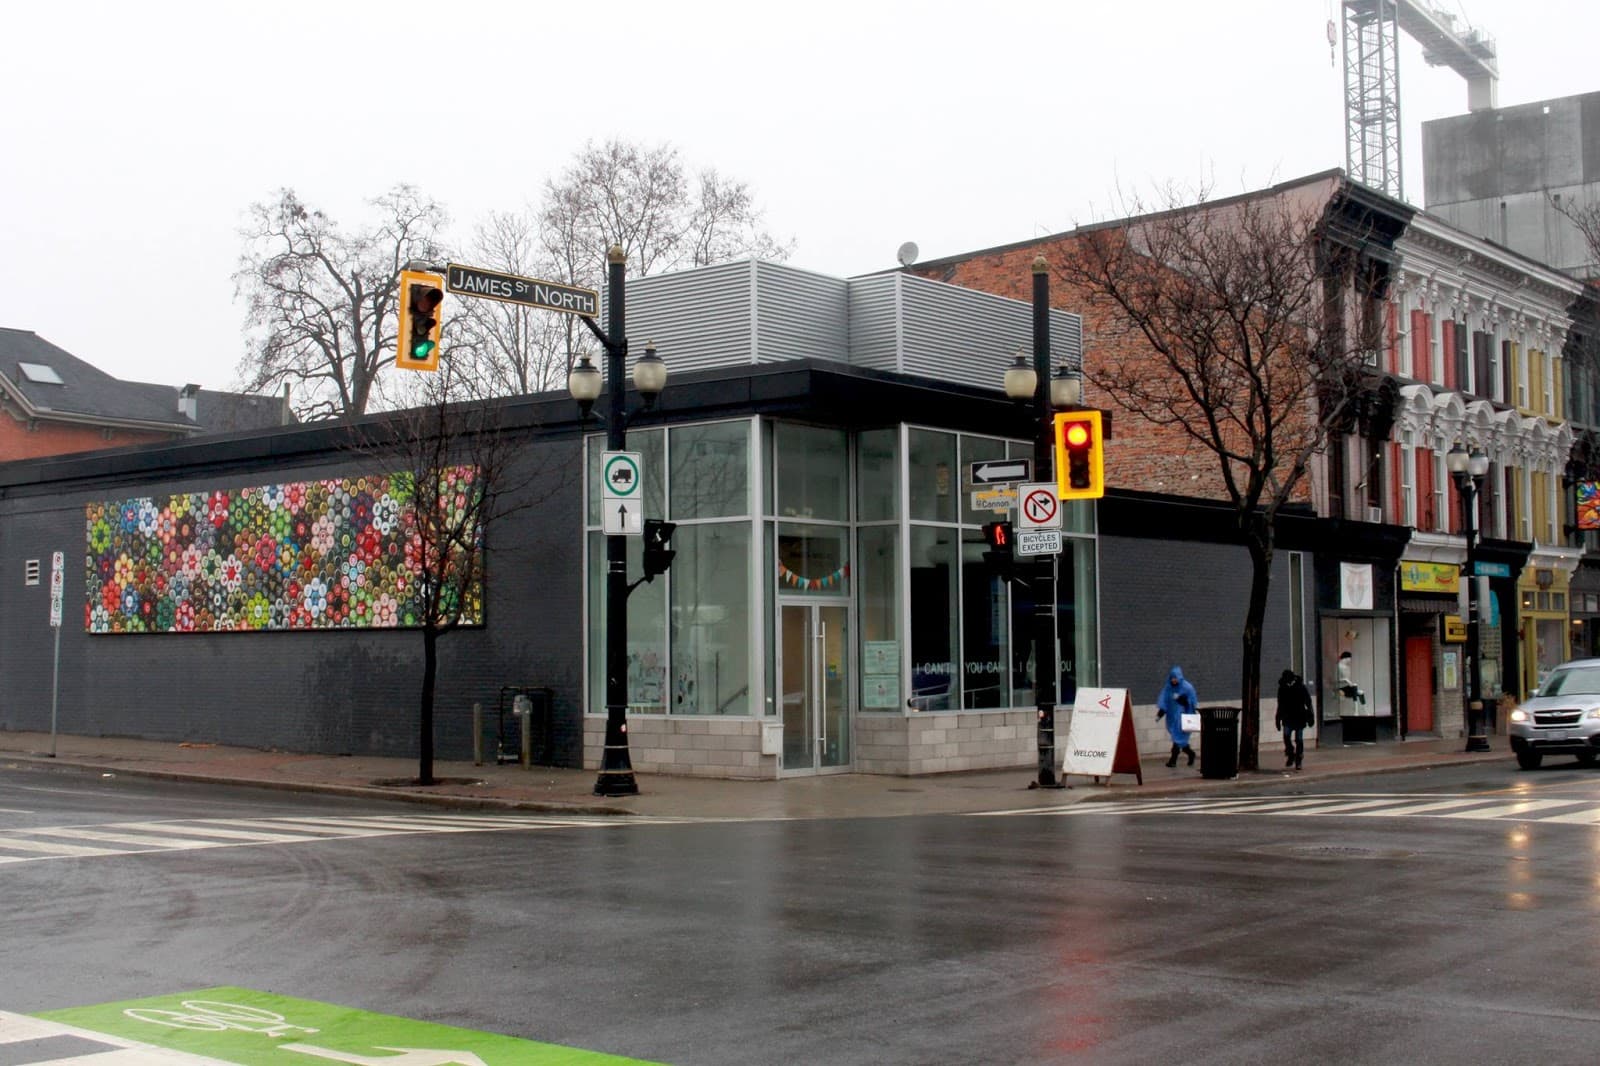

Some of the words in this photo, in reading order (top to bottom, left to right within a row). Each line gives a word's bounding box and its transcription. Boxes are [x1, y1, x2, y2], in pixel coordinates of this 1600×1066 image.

[452, 270, 512, 297] JAMES
[535, 285, 595, 312] NORTH
[982, 500, 1009, 509] Cannon
[1023, 534, 1056, 543] BICYCLES
[1022, 543, 1058, 551] EXCEPTED
[965, 661, 983, 674] YOU
[1073, 749, 1108, 758] WELCOME
